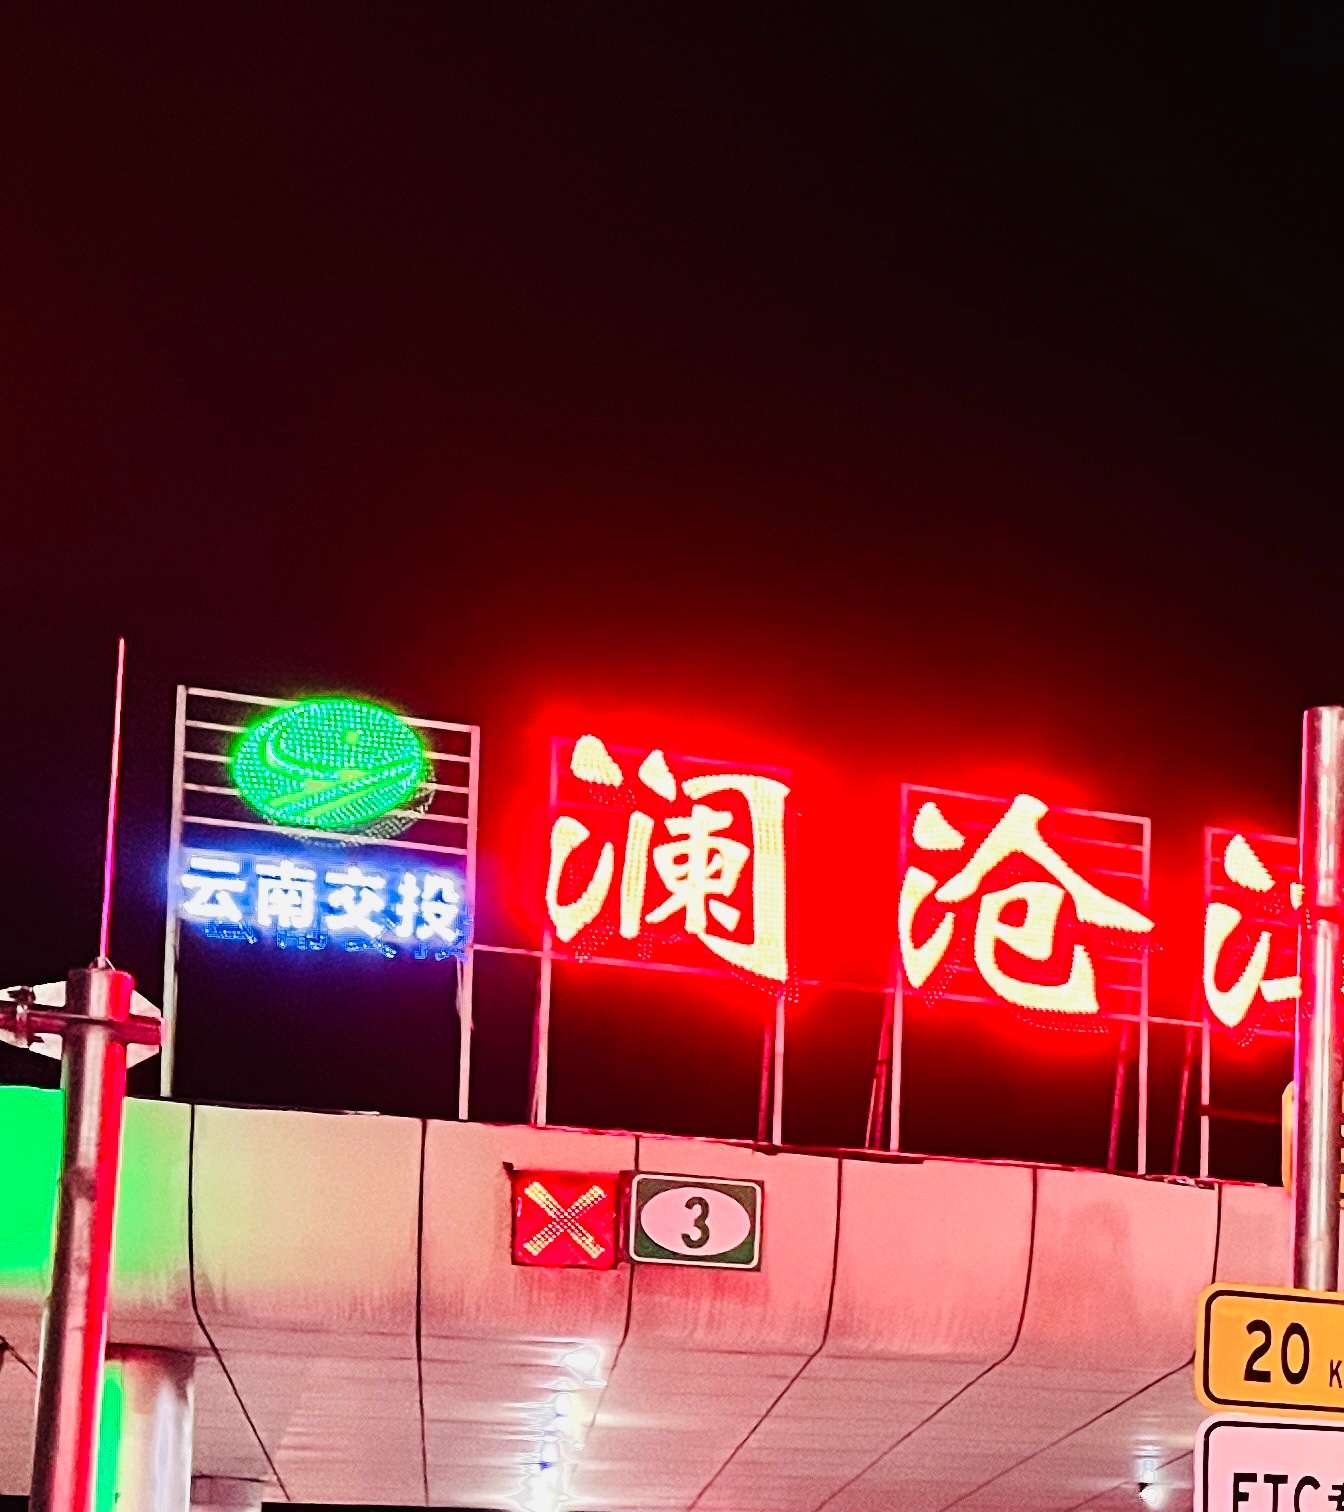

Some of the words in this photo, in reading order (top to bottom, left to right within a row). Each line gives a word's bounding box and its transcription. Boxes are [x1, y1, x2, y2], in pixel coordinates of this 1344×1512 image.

[180, 856, 460, 943] 云南交投
[681, 1196, 710, 1249] 3
[1243, 1319, 1310, 1385] 20
